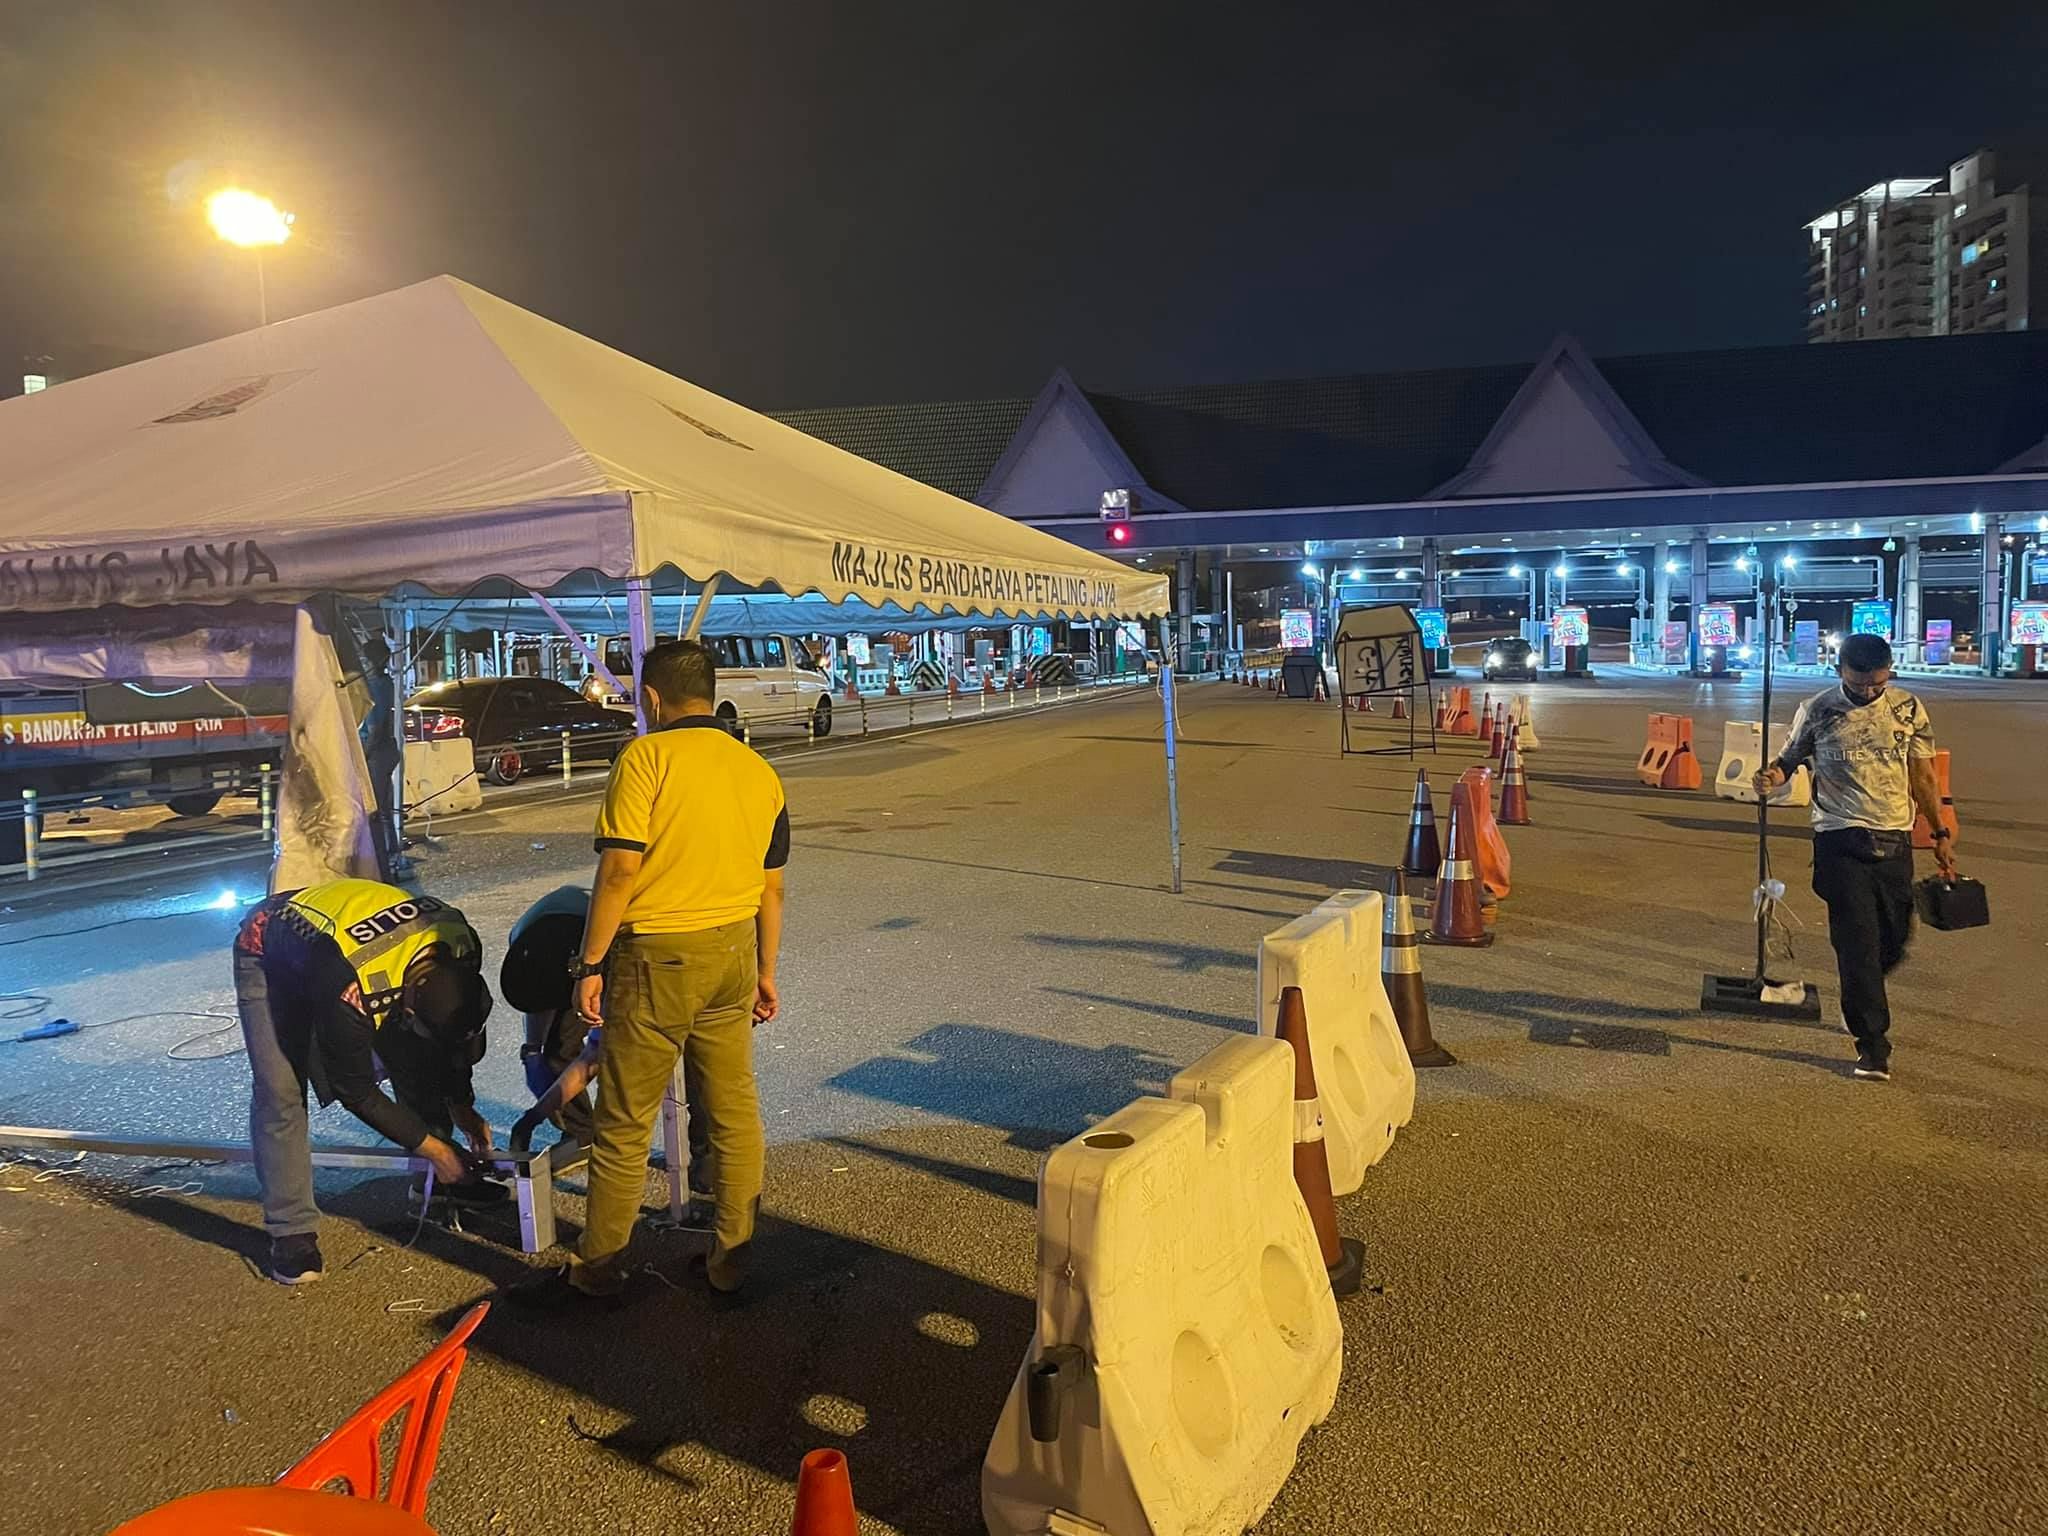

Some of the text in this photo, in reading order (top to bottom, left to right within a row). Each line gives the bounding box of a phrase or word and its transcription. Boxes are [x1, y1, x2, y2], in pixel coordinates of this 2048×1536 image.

[155, 539, 279, 589] JAYA
[831, 541, 1117, 608] MAJLIS BANDARAYA PETALING JAYA
[350, 898, 442, 942] POLIS
